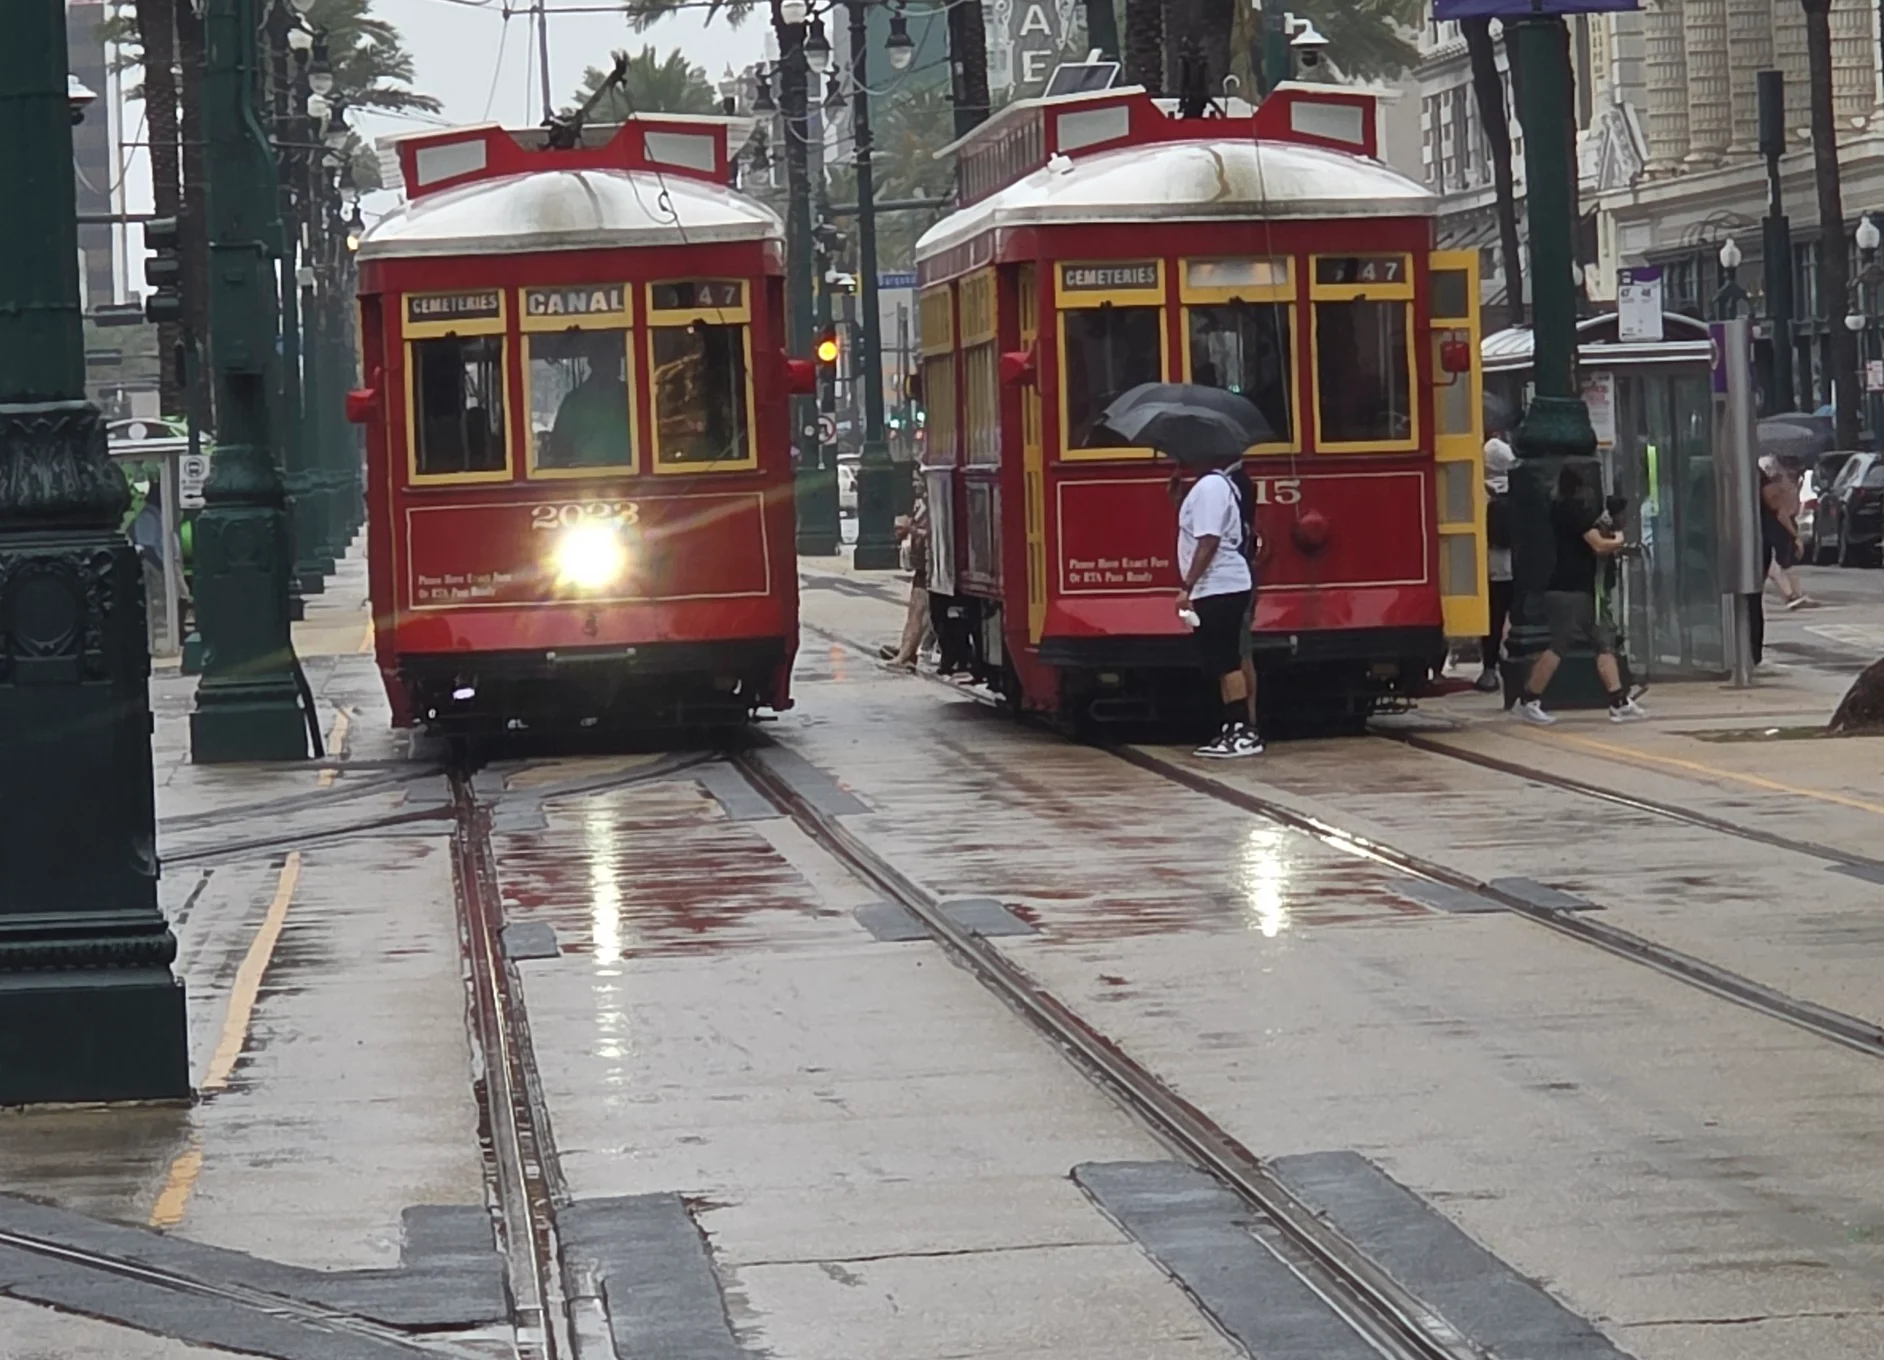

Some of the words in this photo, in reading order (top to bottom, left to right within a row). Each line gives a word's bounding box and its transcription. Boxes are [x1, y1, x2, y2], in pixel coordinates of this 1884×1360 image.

[1066, 267, 1154, 286] CEMETERIES
[412, 295, 498, 314] CEMETERIES
[528, 291, 623, 314] CANAL
[531, 501, 639, 529] 2023
